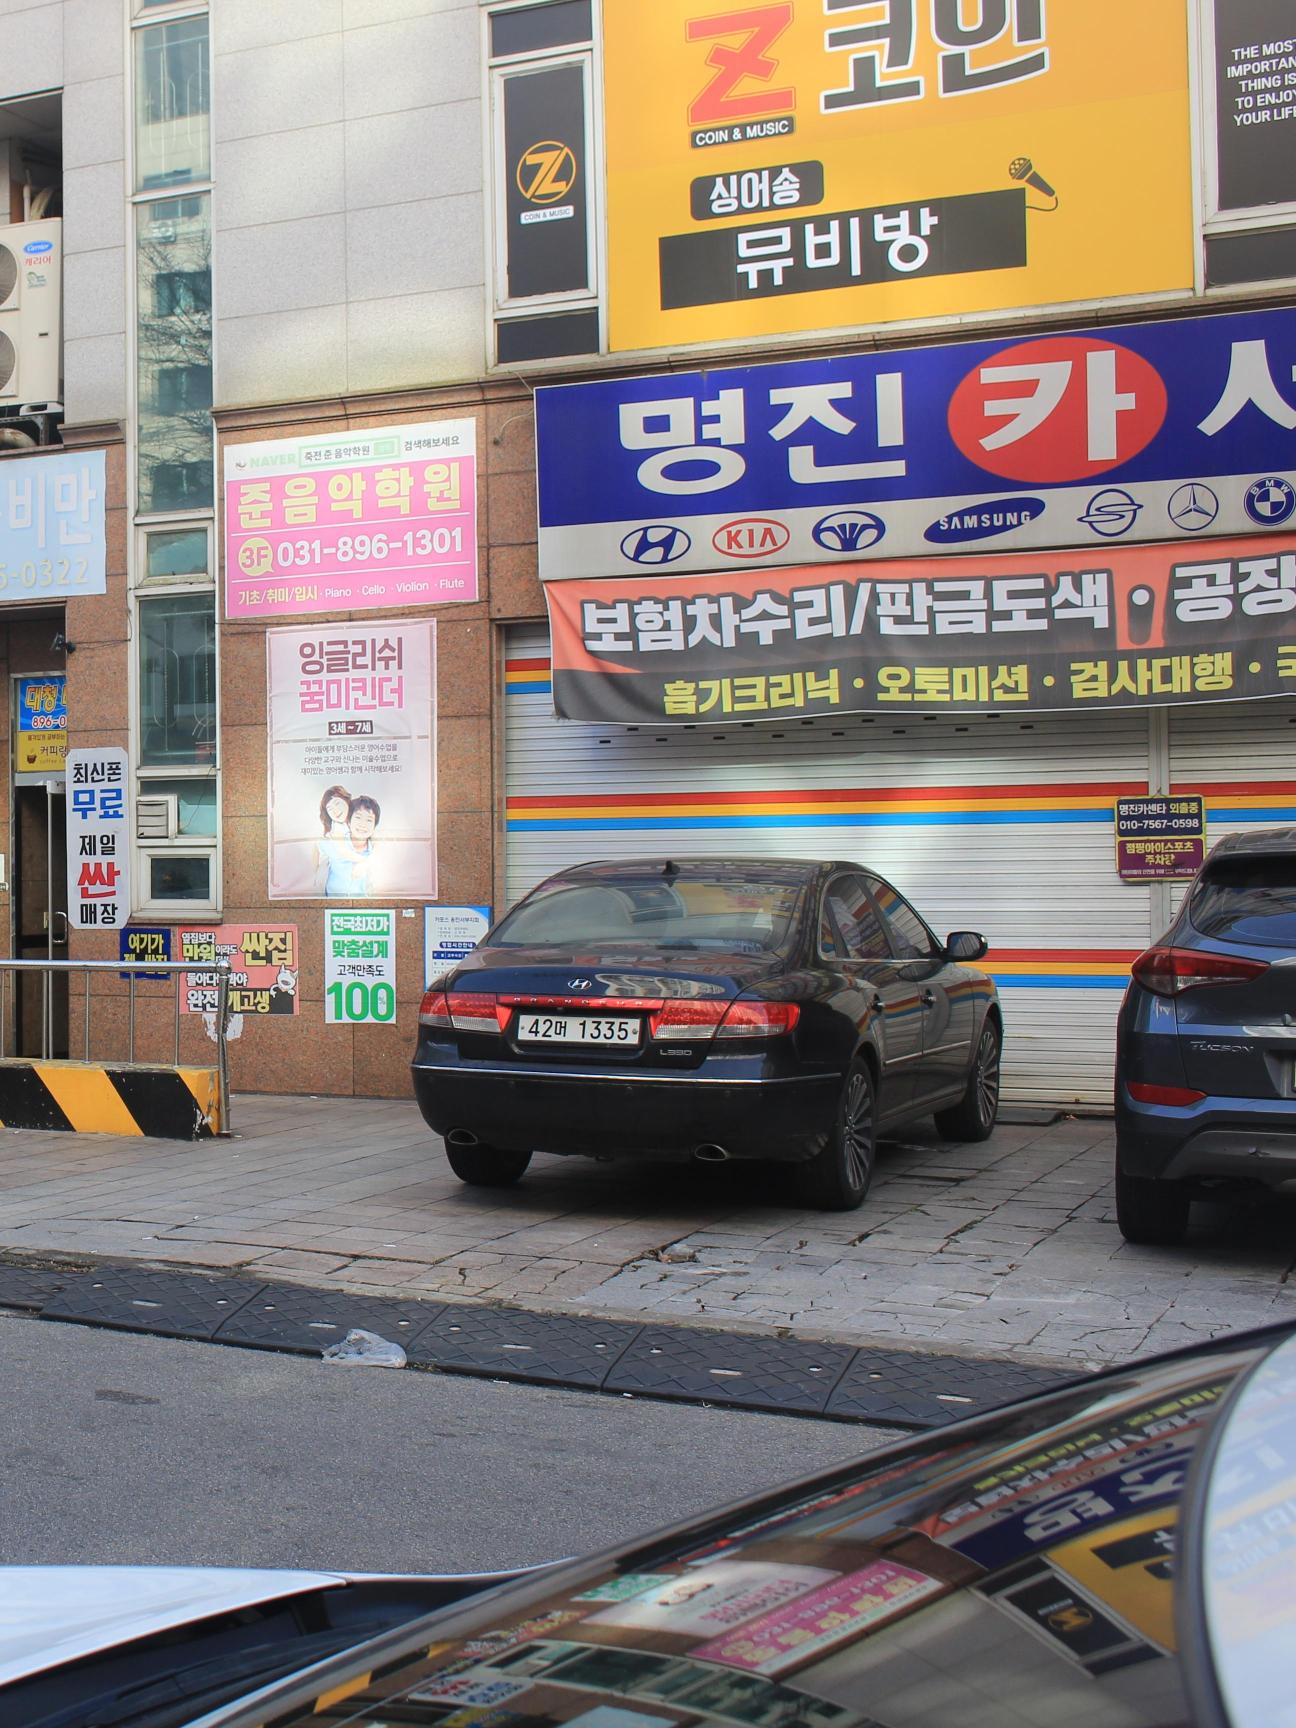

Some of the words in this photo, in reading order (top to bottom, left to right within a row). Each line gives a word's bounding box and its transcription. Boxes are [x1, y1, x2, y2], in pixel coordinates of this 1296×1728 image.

[820, 0, 1049, 114] 코인
[1232, 45, 1259, 61] THE
[1238, 75, 1281, 93] THING
[1235, 96, 1253, 110] TO
[1233, 110, 1271, 127] YOUR
[696, 130, 728, 146] COIN
[732, 127, 742, 141] &
[746, 121, 789, 139] MUSIC
[709, 167, 800, 215] 싱어송
[524, 211, 540, 221] COIN
[549, 208, 571, 218] MUSIC
[736, 206, 939, 289] 뮤비방
[404, 435, 460, 452] 검색해보세요
[618, 371, 906, 495] 명진
[249, 454, 296, 469] NAVER
[238, 462, 461, 529] 준음악학원
[938, 510, 1032, 533] SAMSUNG
[241, 546, 270, 569] 3F
[277, 527, 462, 567] 031-896-1301
[724, 527, 778, 551] KIA
[325, 587, 351, 598] Piano
[362, 585, 385, 596] Cello
[439, 578, 464, 590] Flute
[299, 637, 403, 675] 잉글리쉬
[299, 676, 403, 712] 꿈미킨더
[663, 667, 840, 716] 흡기크리닉
[876, 663, 1029, 705] 오토미션
[1070, 652, 1233, 699] 검사대행
[73, 761, 122, 783] 최신폰
[72, 788, 124, 820] 무료
[1119, 803, 1166, 815] 명진카센타
[1169, 802, 1199, 814] 외출중
[1119, 819, 1200, 830] 010-7567-0598
[79, 834, 116, 856] 제일
[78, 862, 121, 900] 싼
[80, 903, 119, 925] 매장
[332, 915, 389, 932] 전국최저가
[128, 933, 164, 954] 여기가
[240, 931, 293, 966] 싼집
[332, 939, 388, 959] 맞춤설계
[337, 964, 385, 977] 고객만족도
[187, 990, 219, 1012] 완전
[327, 982, 394, 1021] 100
[528, 1018, 567, 1038] 42머
[579, 1020, 629, 1041] 1335
